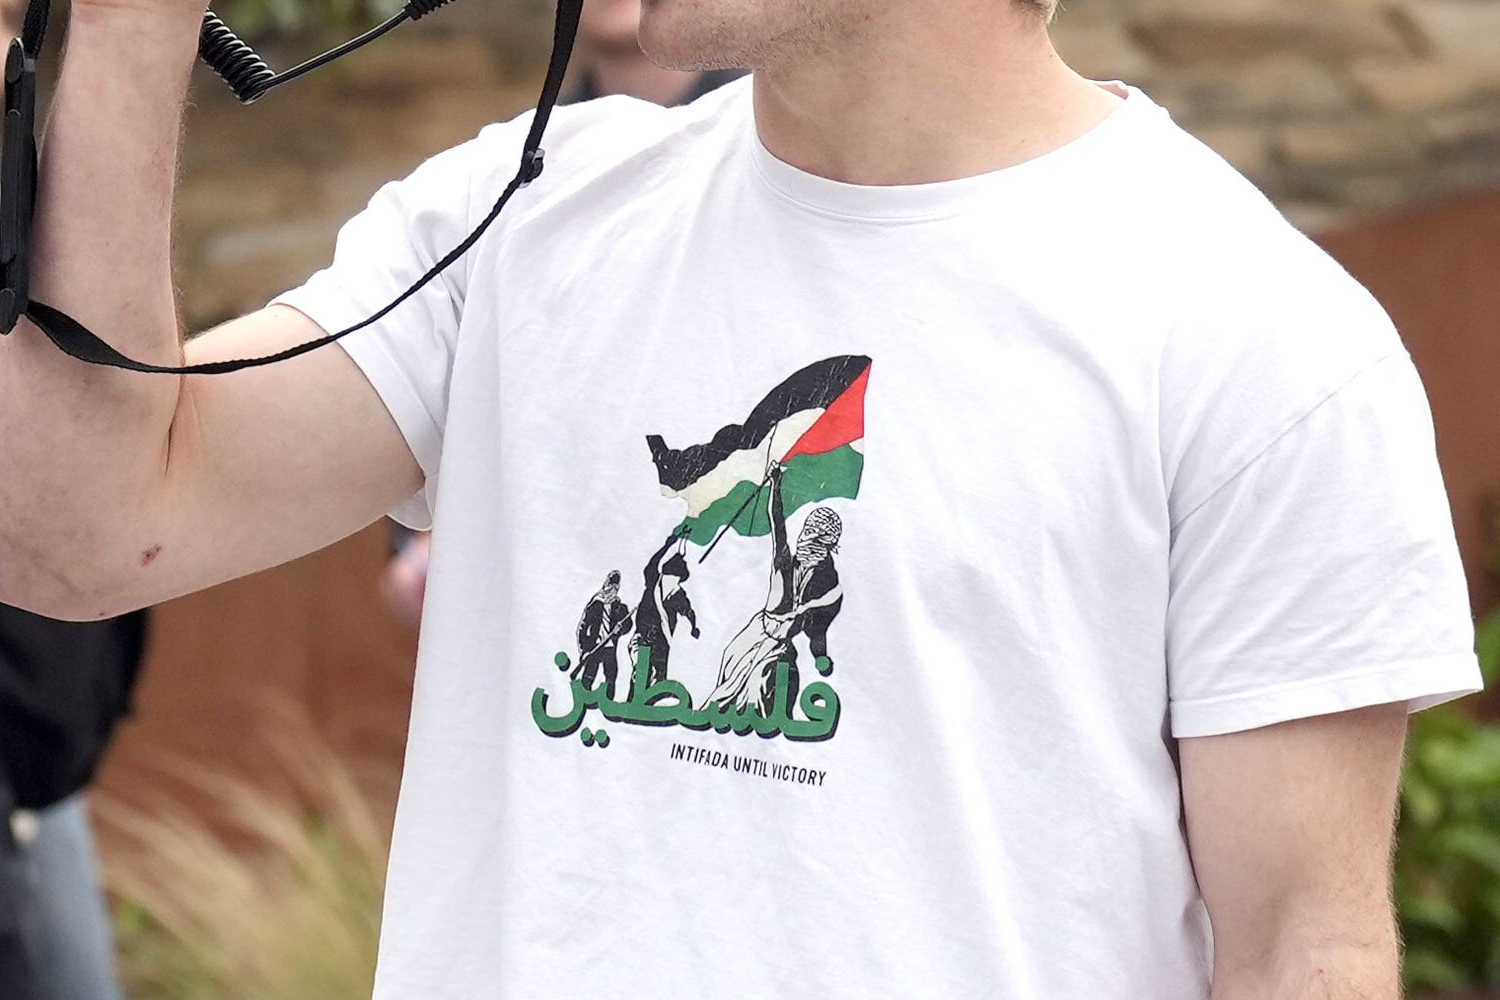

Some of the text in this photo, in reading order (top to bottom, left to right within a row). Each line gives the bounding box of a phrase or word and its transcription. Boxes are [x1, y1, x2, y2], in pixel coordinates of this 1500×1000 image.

[531, 645, 841, 749] فلسطين
[670, 743, 827, 787] INTIFADA UNTIL VICTORY
